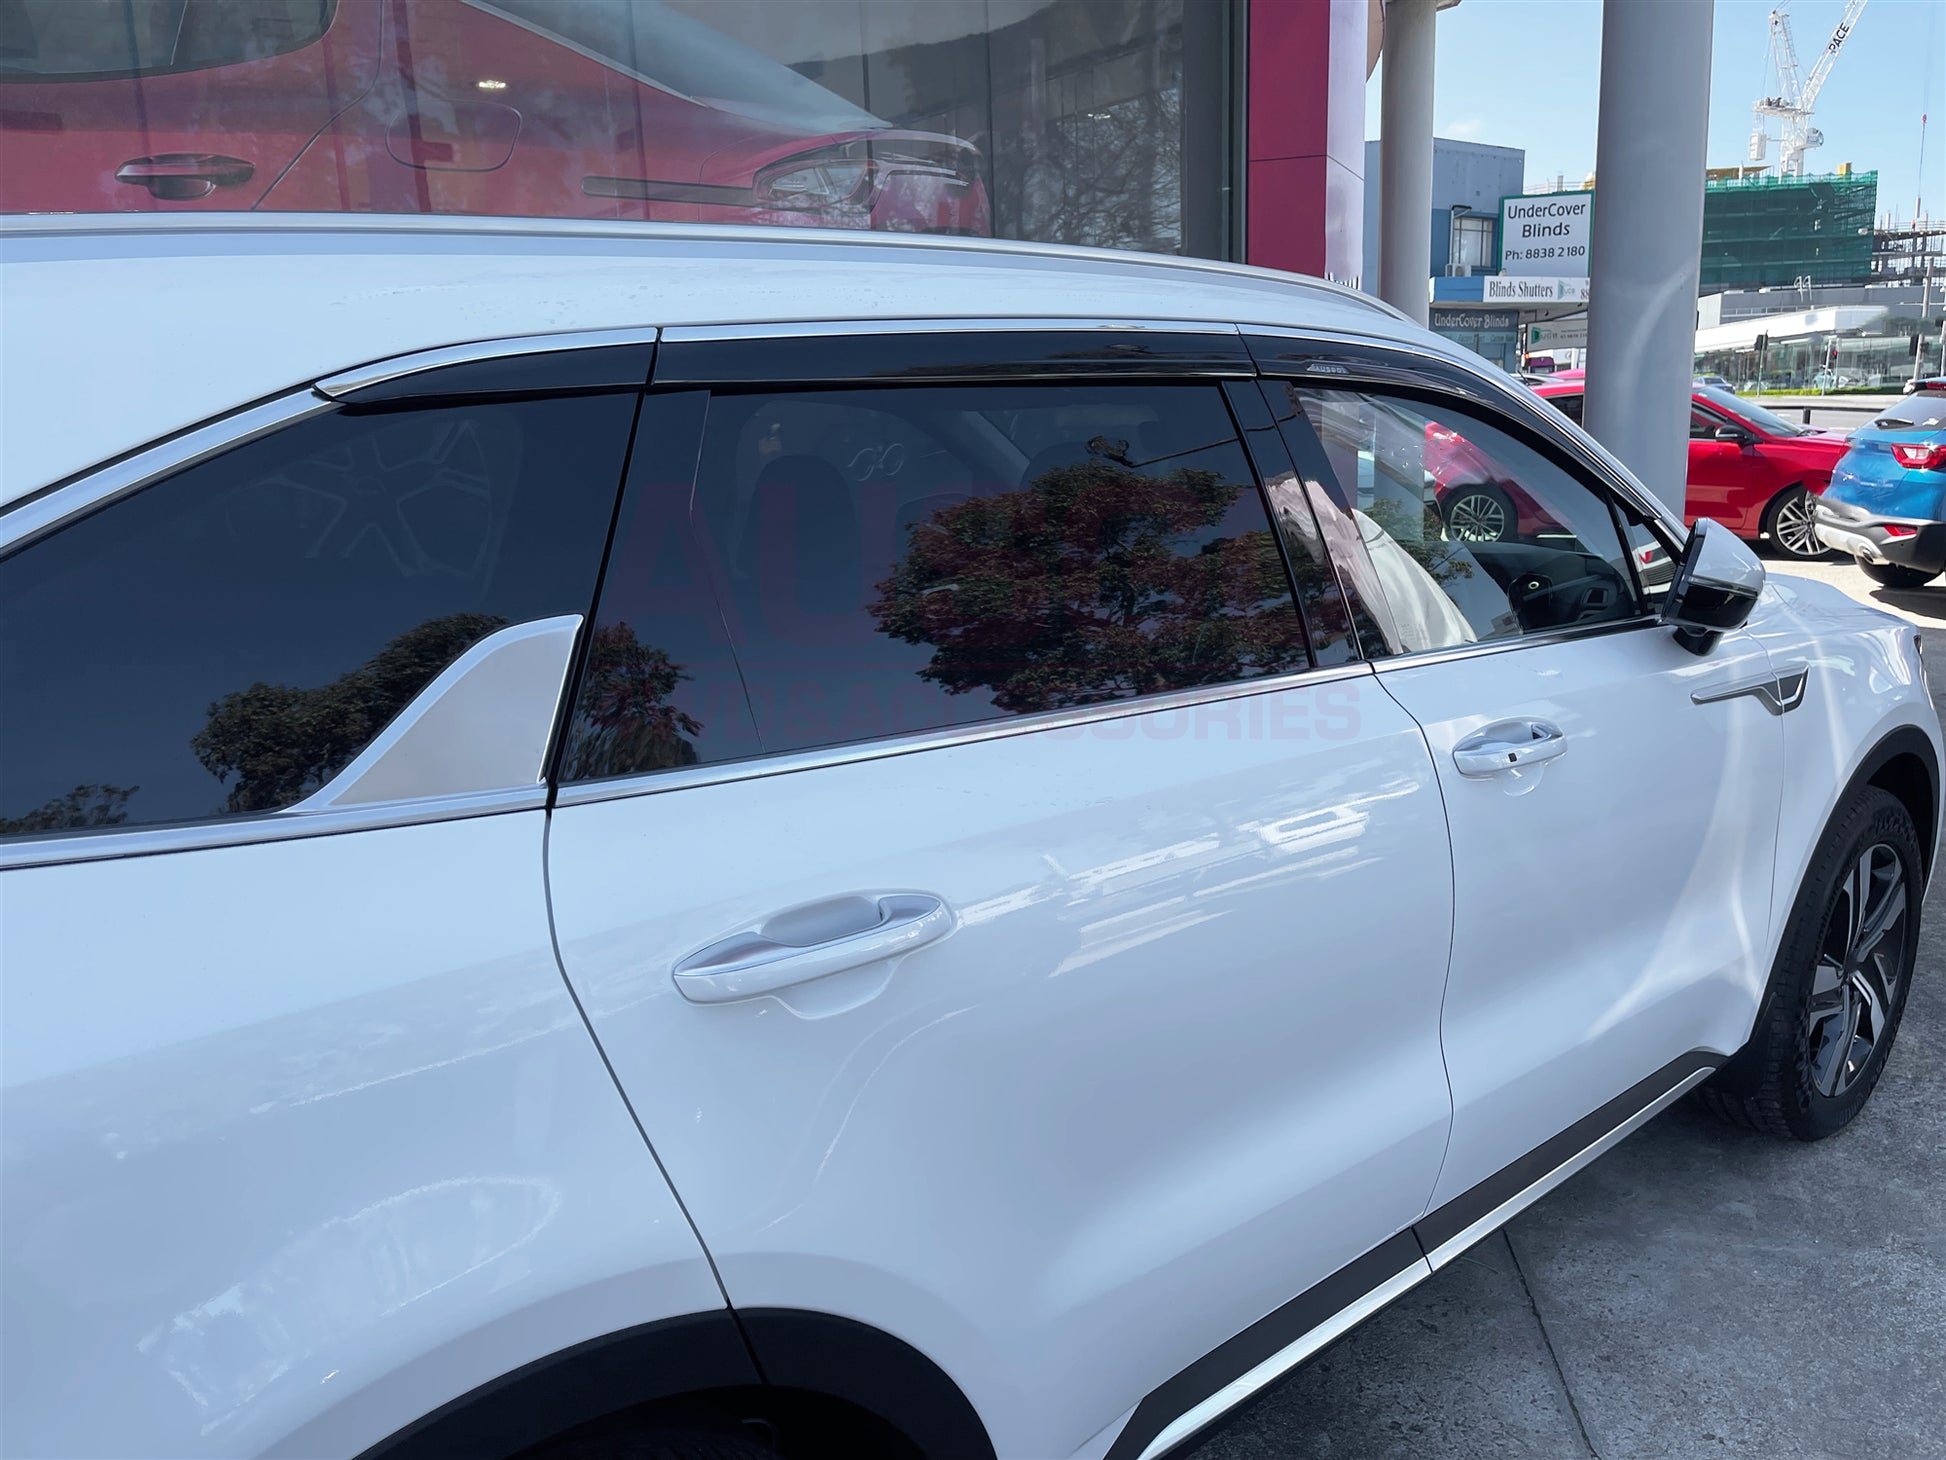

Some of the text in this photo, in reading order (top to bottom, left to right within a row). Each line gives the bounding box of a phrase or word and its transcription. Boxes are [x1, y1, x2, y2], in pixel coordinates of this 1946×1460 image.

[1828, 22, 1850, 54] PACE
[1508, 203, 1586, 219] UnderCover
[1522, 222, 1570, 238] Blinds
[1505, 250, 1523, 260] Ph:
[1525, 248, 1555, 259] 8838
[1489, 278, 1553, 297] Blinds Shutters
[1434, 313, 1509, 328] UnderCover Blinds
